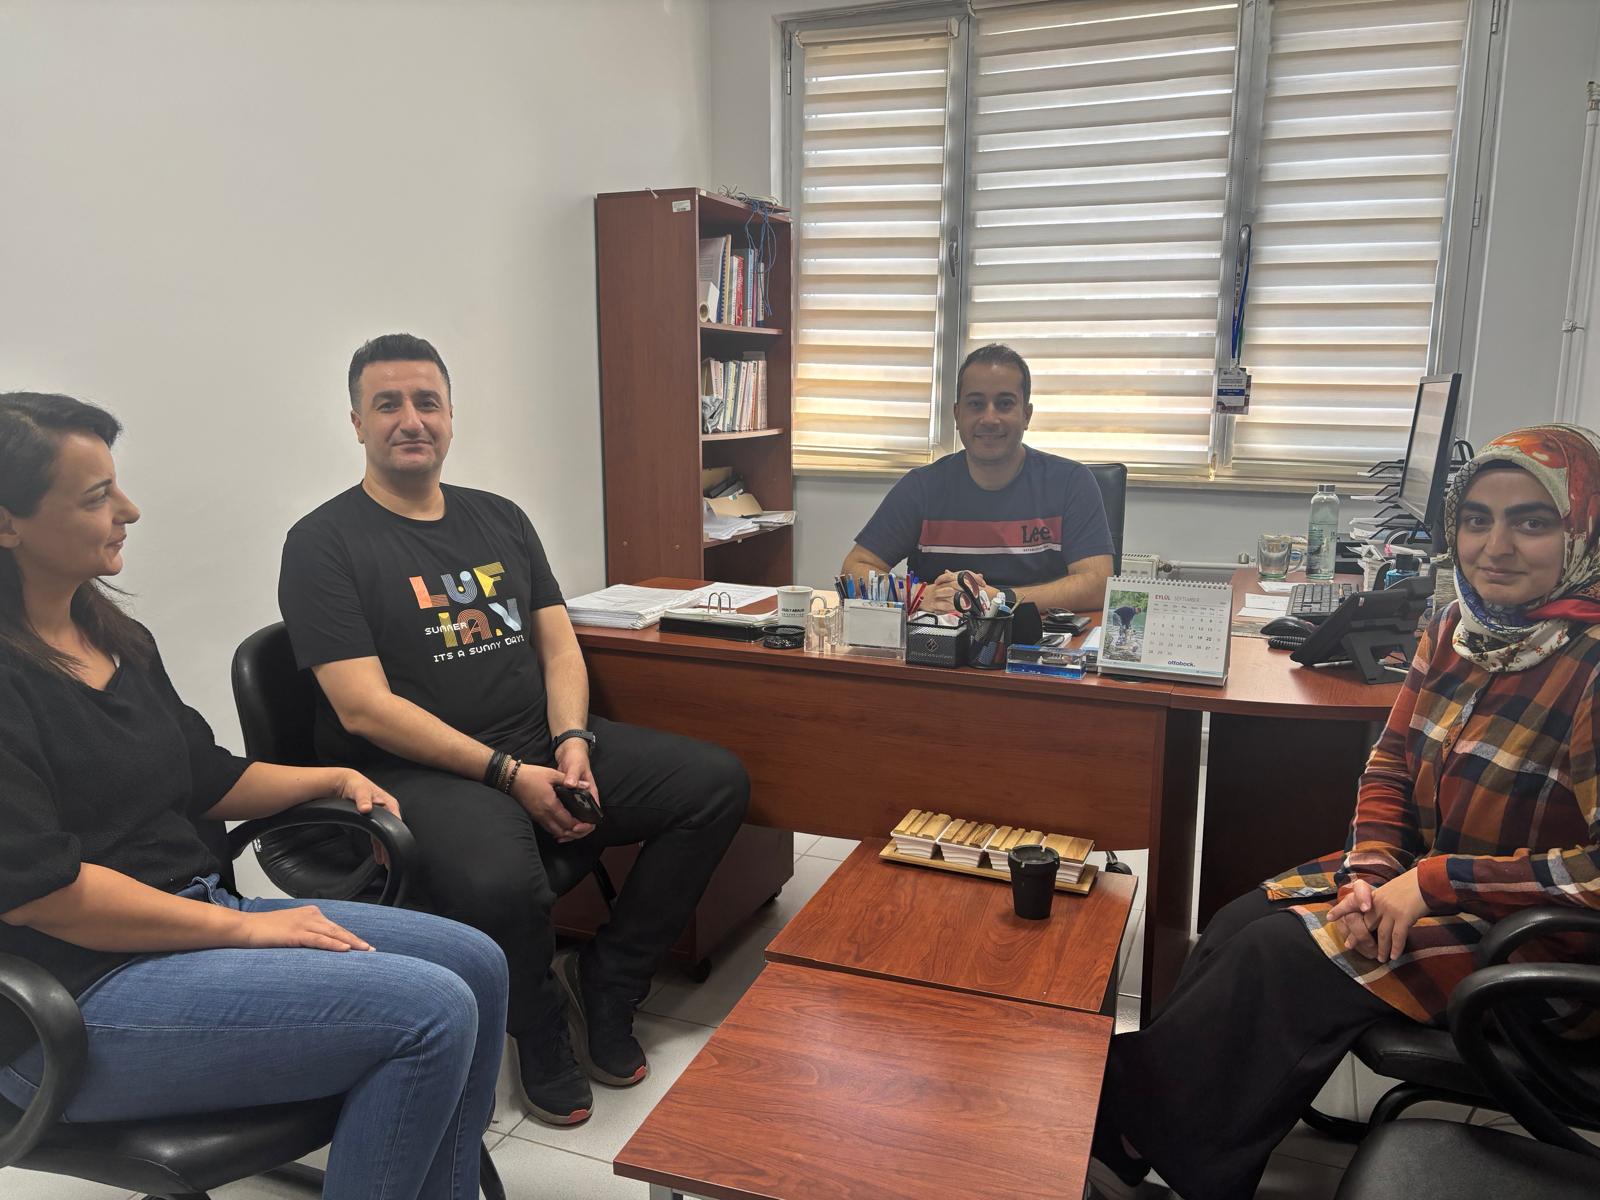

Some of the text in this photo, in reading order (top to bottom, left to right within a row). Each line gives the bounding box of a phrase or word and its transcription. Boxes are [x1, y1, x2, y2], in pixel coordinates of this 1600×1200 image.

[1021, 525, 1051, 544] Lee
[433, 634, 525, 663] ITS A SUNNY DAY!
